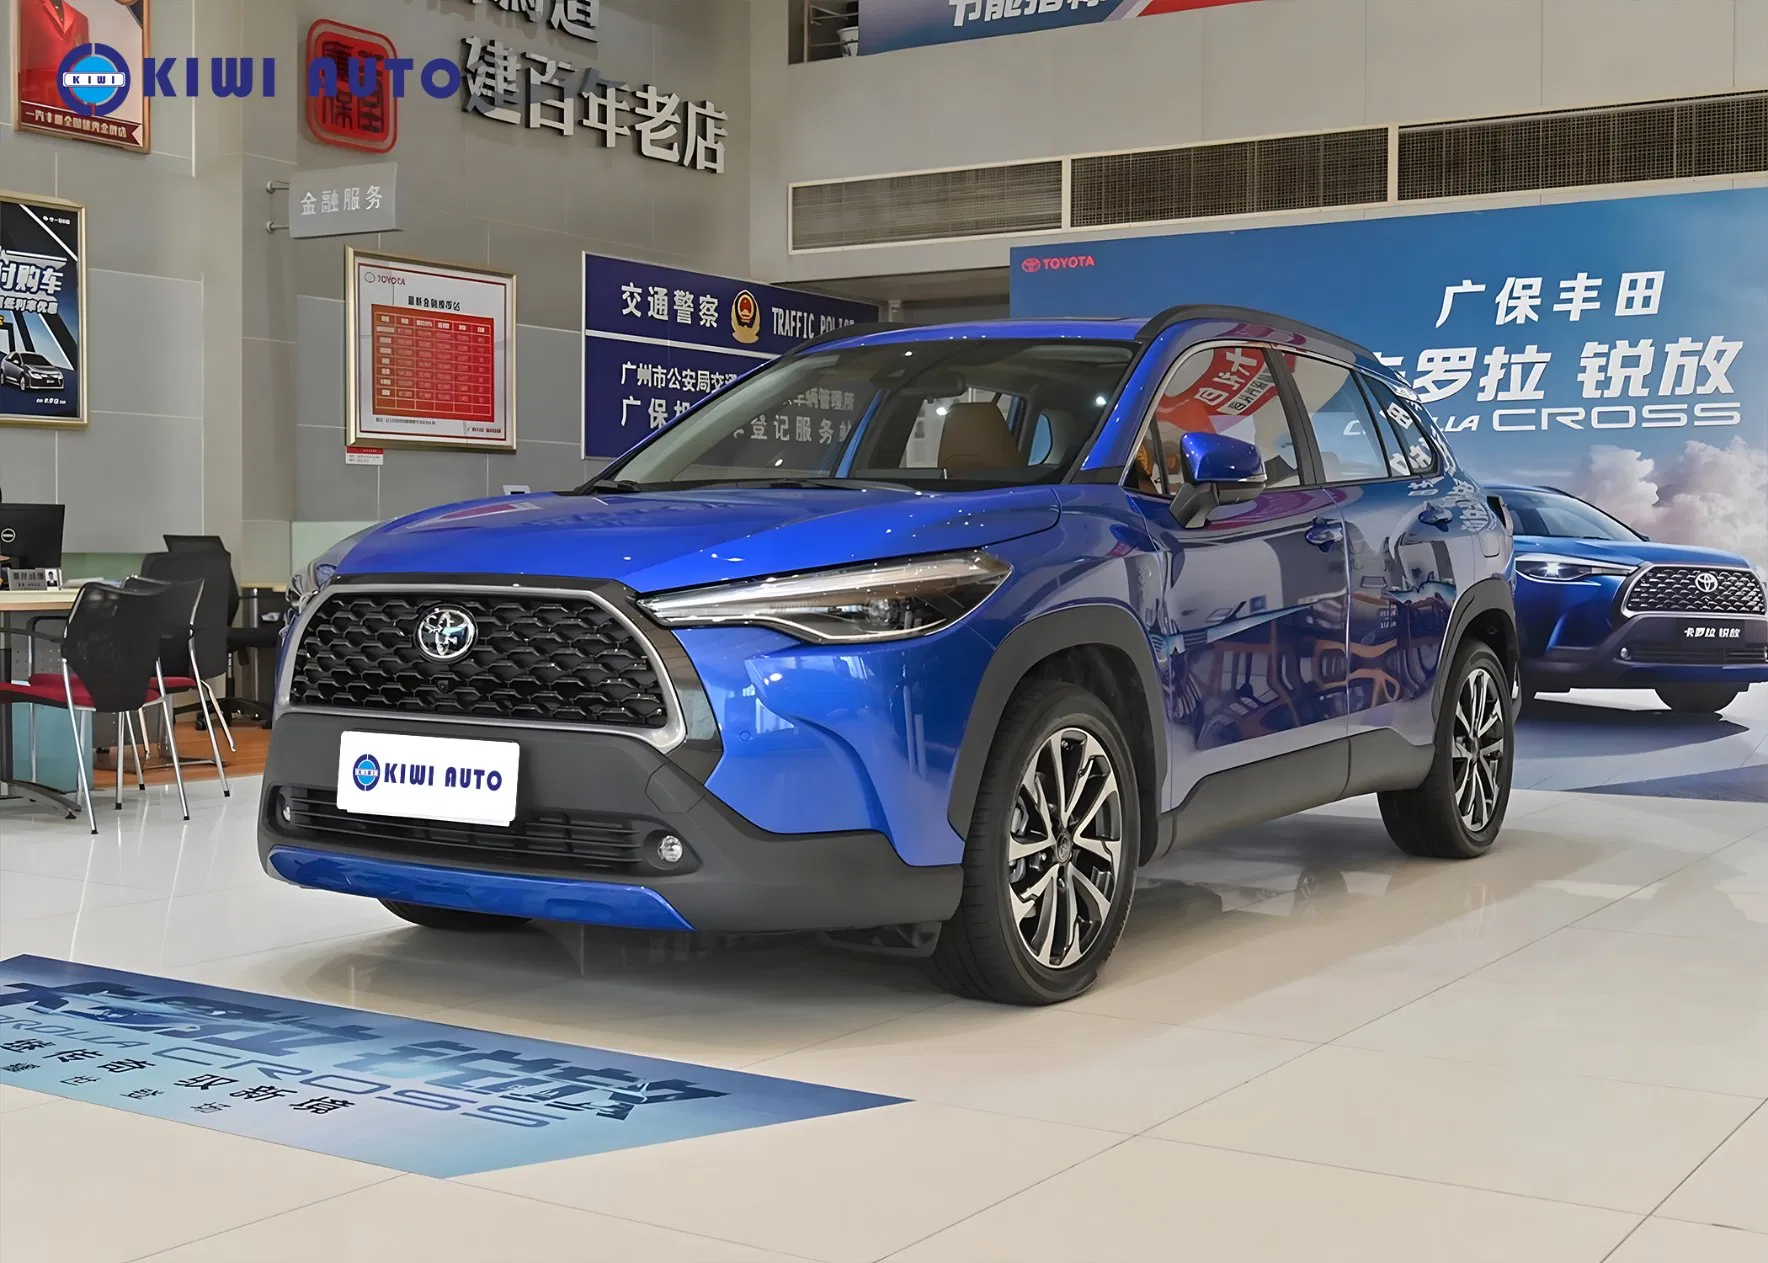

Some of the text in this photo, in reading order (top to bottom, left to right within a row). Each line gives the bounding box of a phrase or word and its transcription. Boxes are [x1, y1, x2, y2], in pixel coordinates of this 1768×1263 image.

[461, 36, 728, 173] 建百年老店
[300, 185, 382, 215] 金融服务
[1042, 255, 1095, 270] TOYOTA
[621, 282, 718, 328] 交通警察
[1435, 271, 1665, 328] 广保丰田
[771, 307, 815, 339] TRAFFIC
[1577, 336, 1744, 398] 锐放
[1492, 402, 1741, 431] CROSS
[152, 1047, 567, 1128] CROSS
